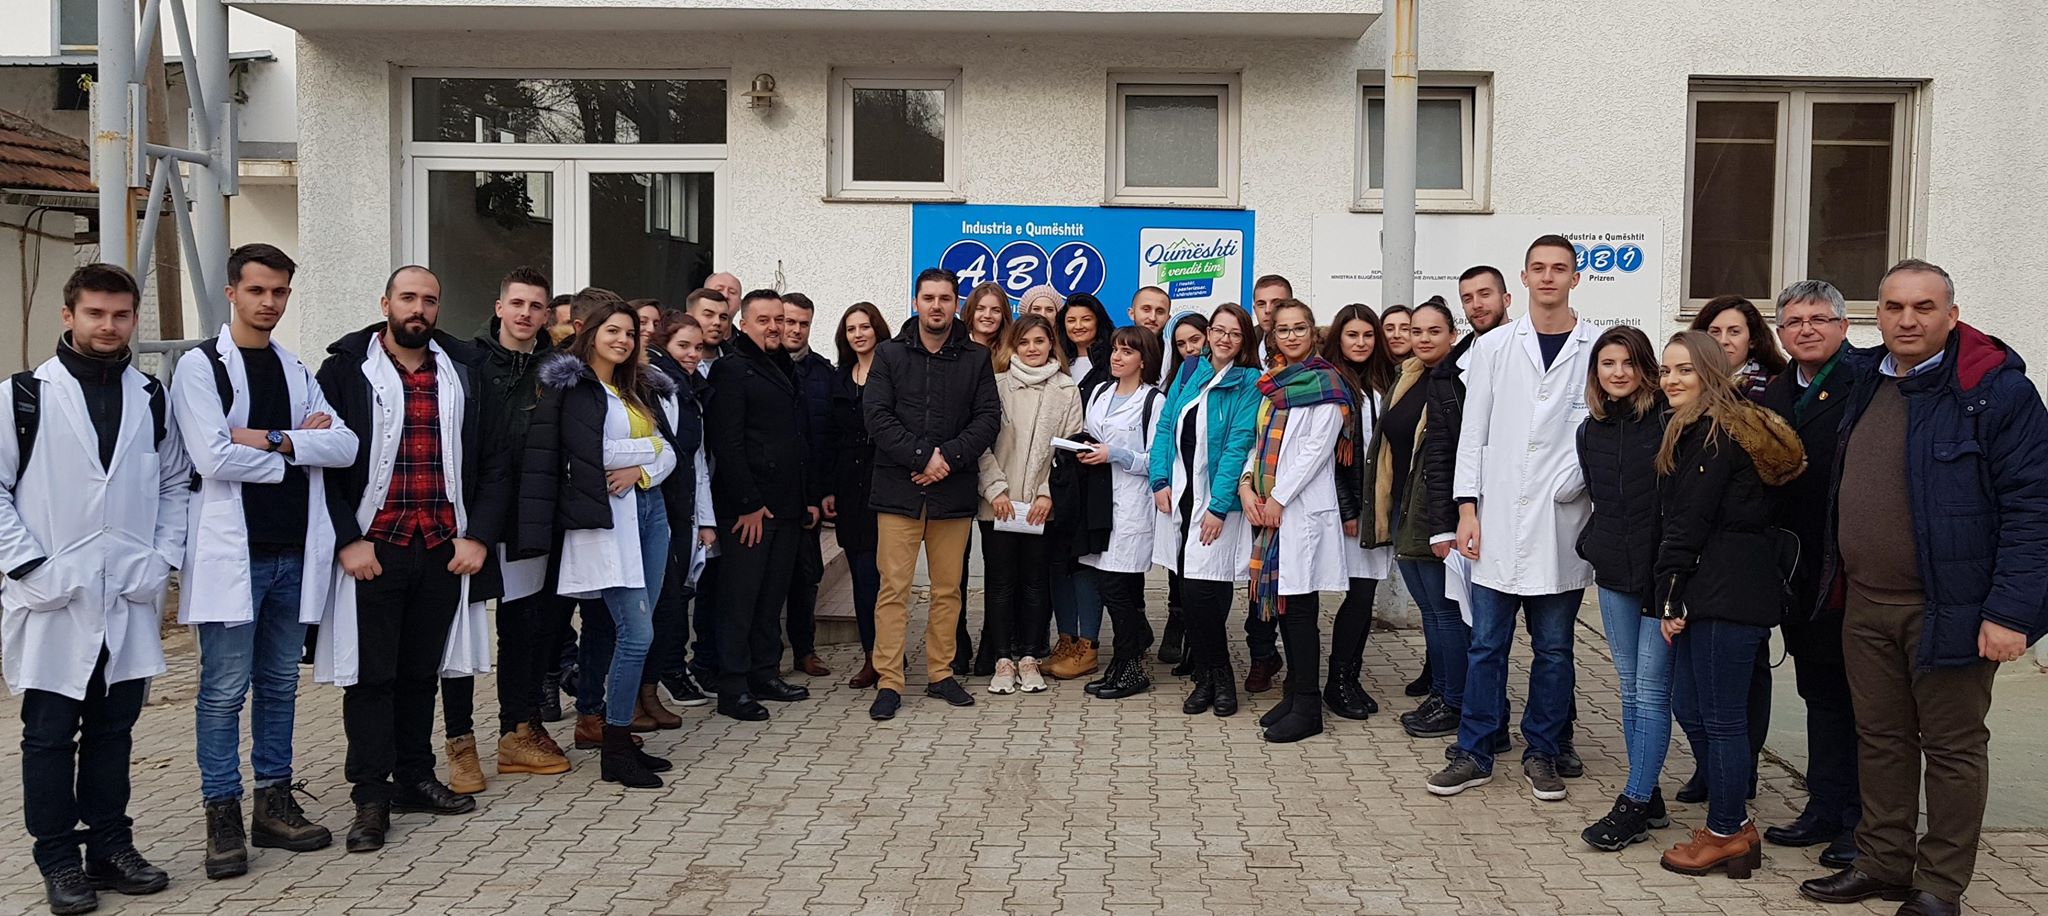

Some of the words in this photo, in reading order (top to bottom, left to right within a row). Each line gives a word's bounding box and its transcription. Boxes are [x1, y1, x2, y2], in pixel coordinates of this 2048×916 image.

[961, 220, 1013, 235] Industria
[1015, 224, 1023, 235] e
[1025, 222, 1084, 237] Qumështit
[1605, 233, 1645, 241] Qumështit
[1144, 238, 1238, 267] Qumështi
[1160, 267, 1167, 277] i
[1168, 261, 1203, 276] vendit
[1203, 261, 1222, 273] tim
[1589, 274, 1615, 282] Prizren
[1593, 317, 1641, 327] qumështit
